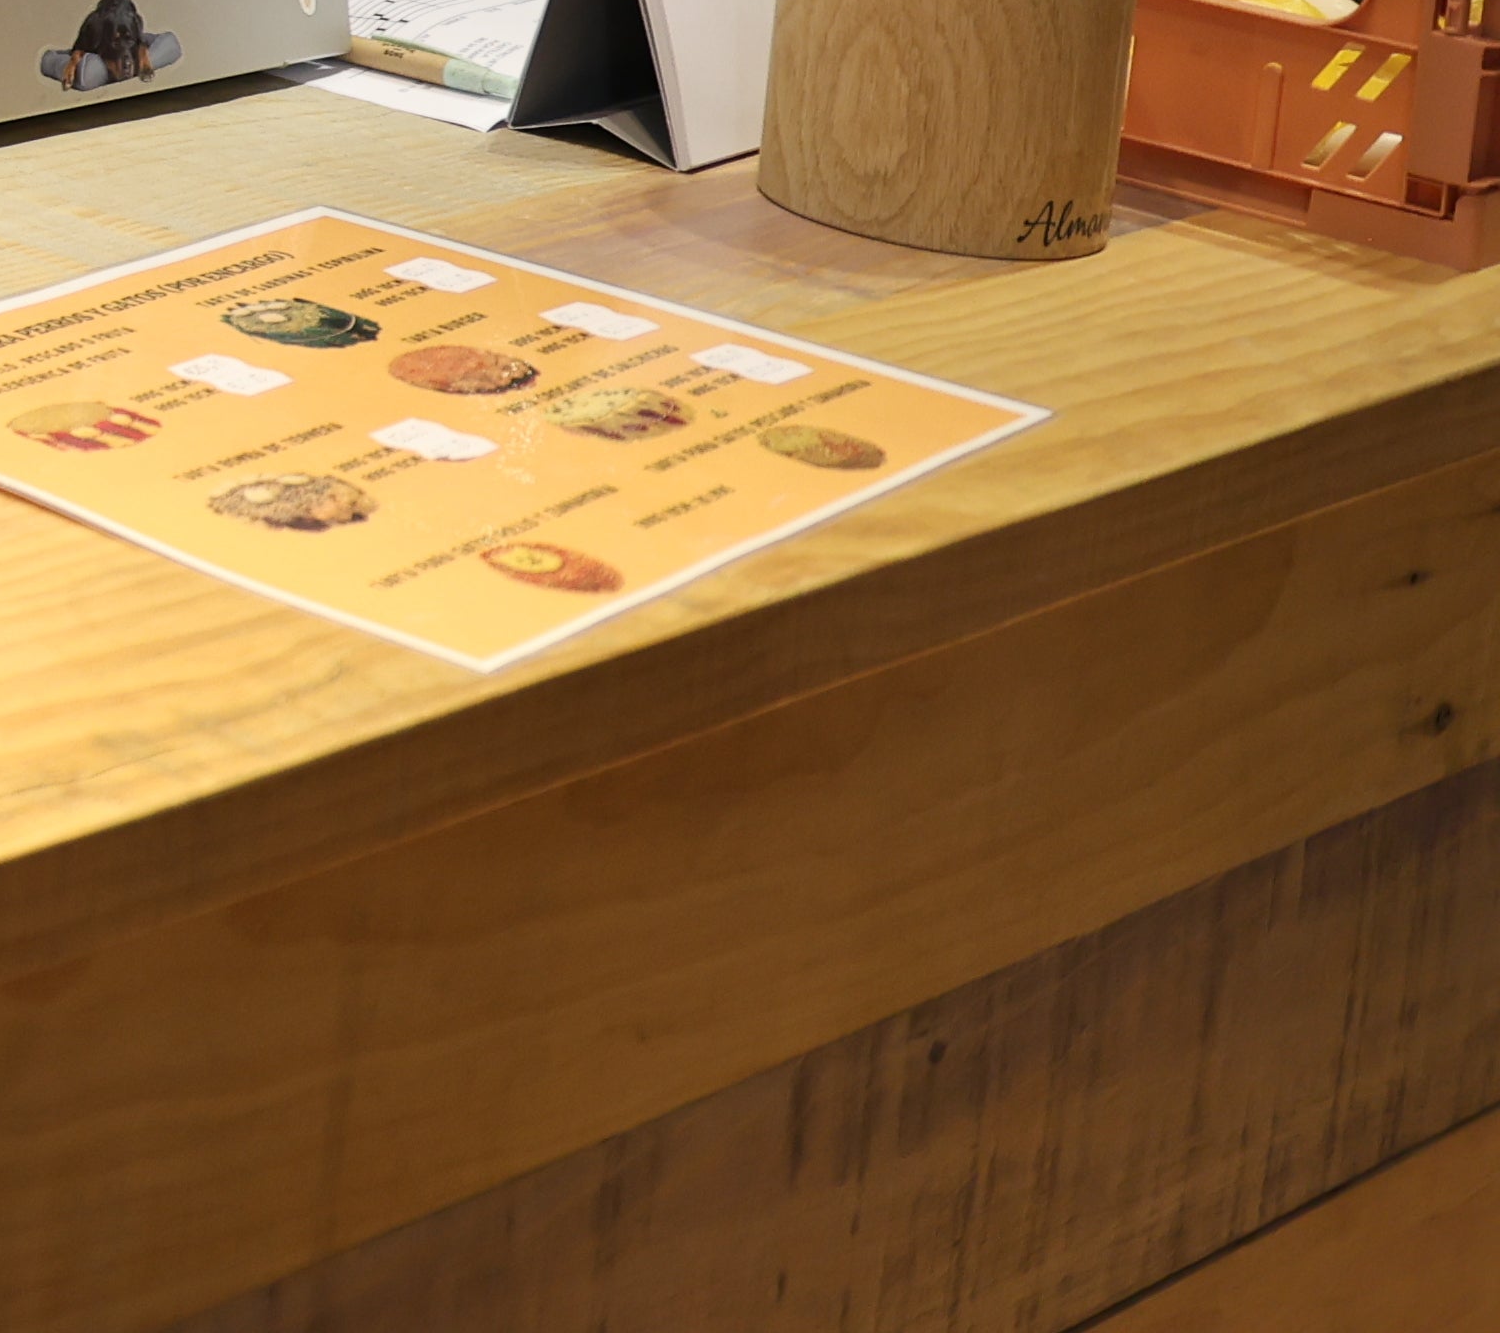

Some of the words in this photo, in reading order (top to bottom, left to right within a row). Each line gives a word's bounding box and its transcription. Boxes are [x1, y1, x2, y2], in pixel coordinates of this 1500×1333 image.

[15, 310, 95, 339] PERROS
[101, 287, 165, 314] GATOS
[201, 249, 296, 284] ENCARGO)
